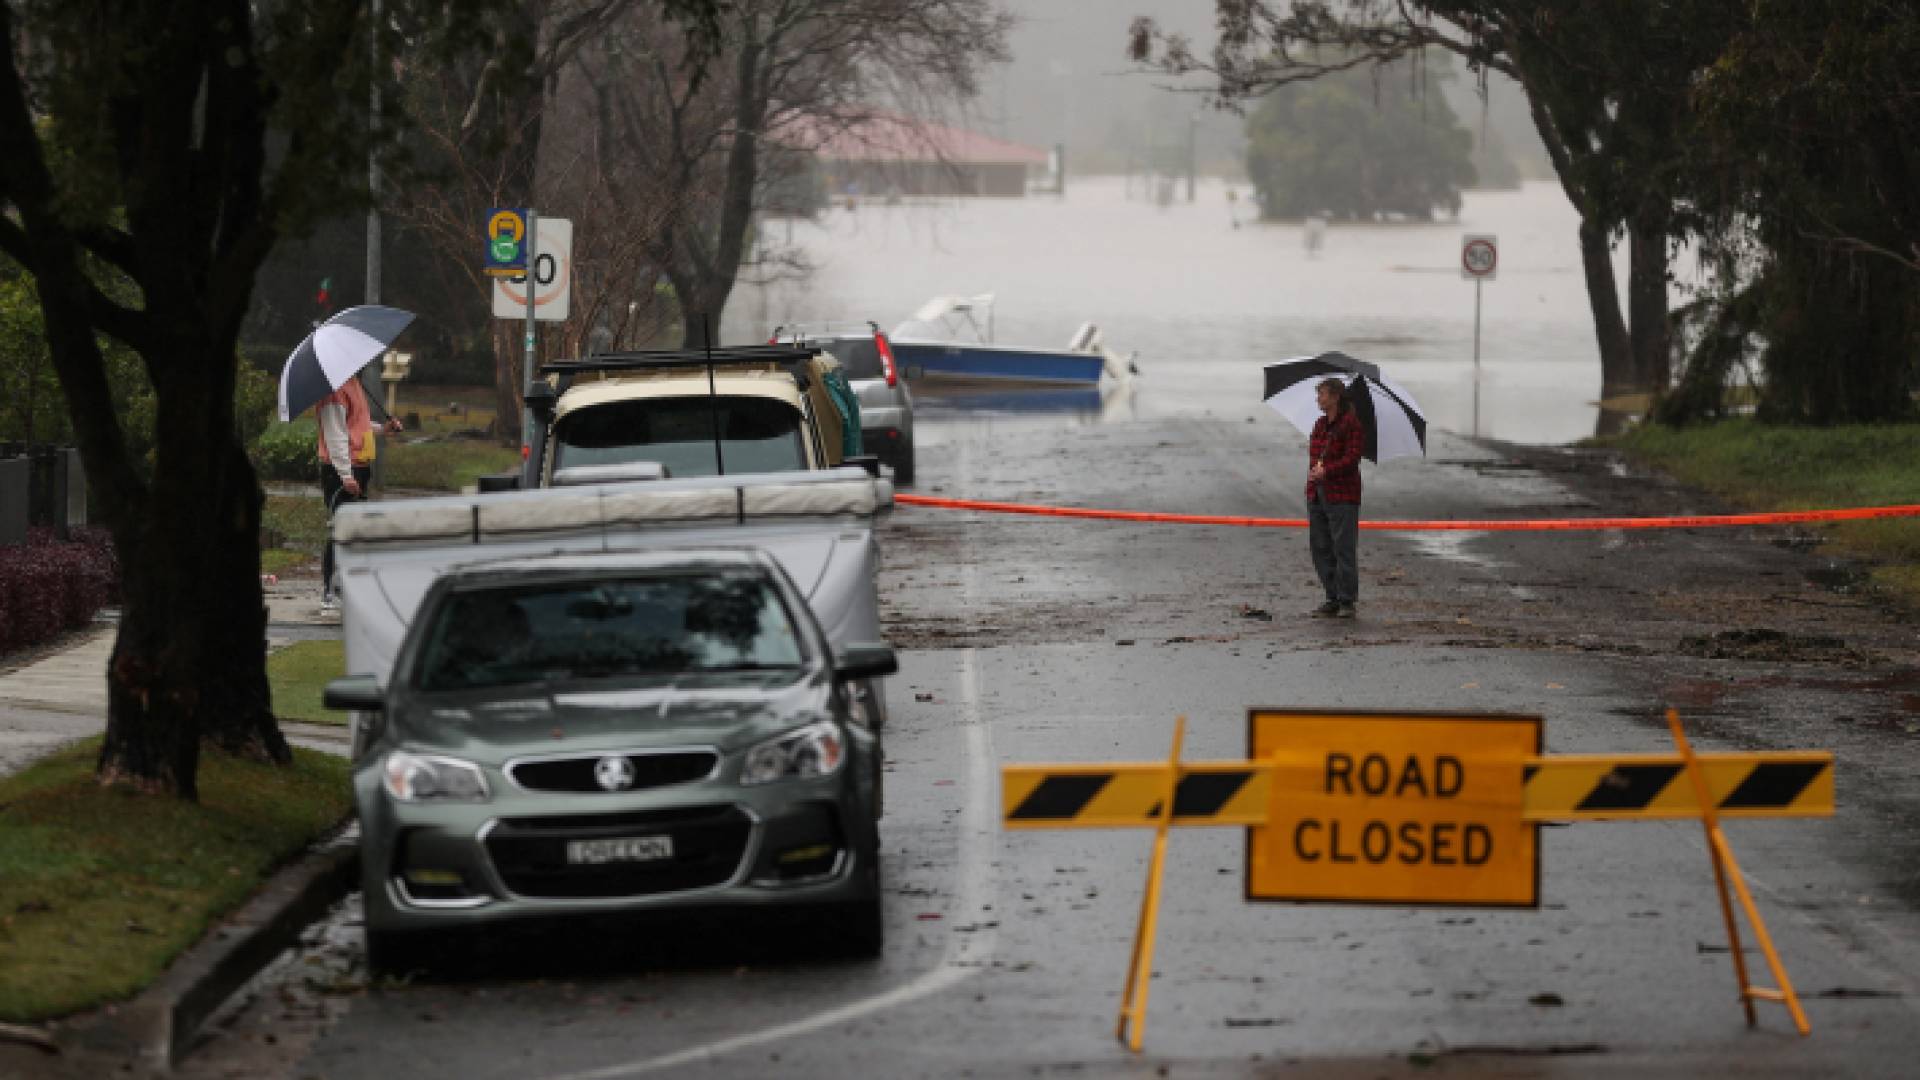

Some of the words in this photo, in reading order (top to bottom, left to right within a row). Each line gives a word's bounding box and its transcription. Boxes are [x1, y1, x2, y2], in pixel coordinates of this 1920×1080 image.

[510, 253, 556, 285] 0
[1325, 752, 1463, 797] ROAD
[1294, 819, 1493, 865] CLOSED
